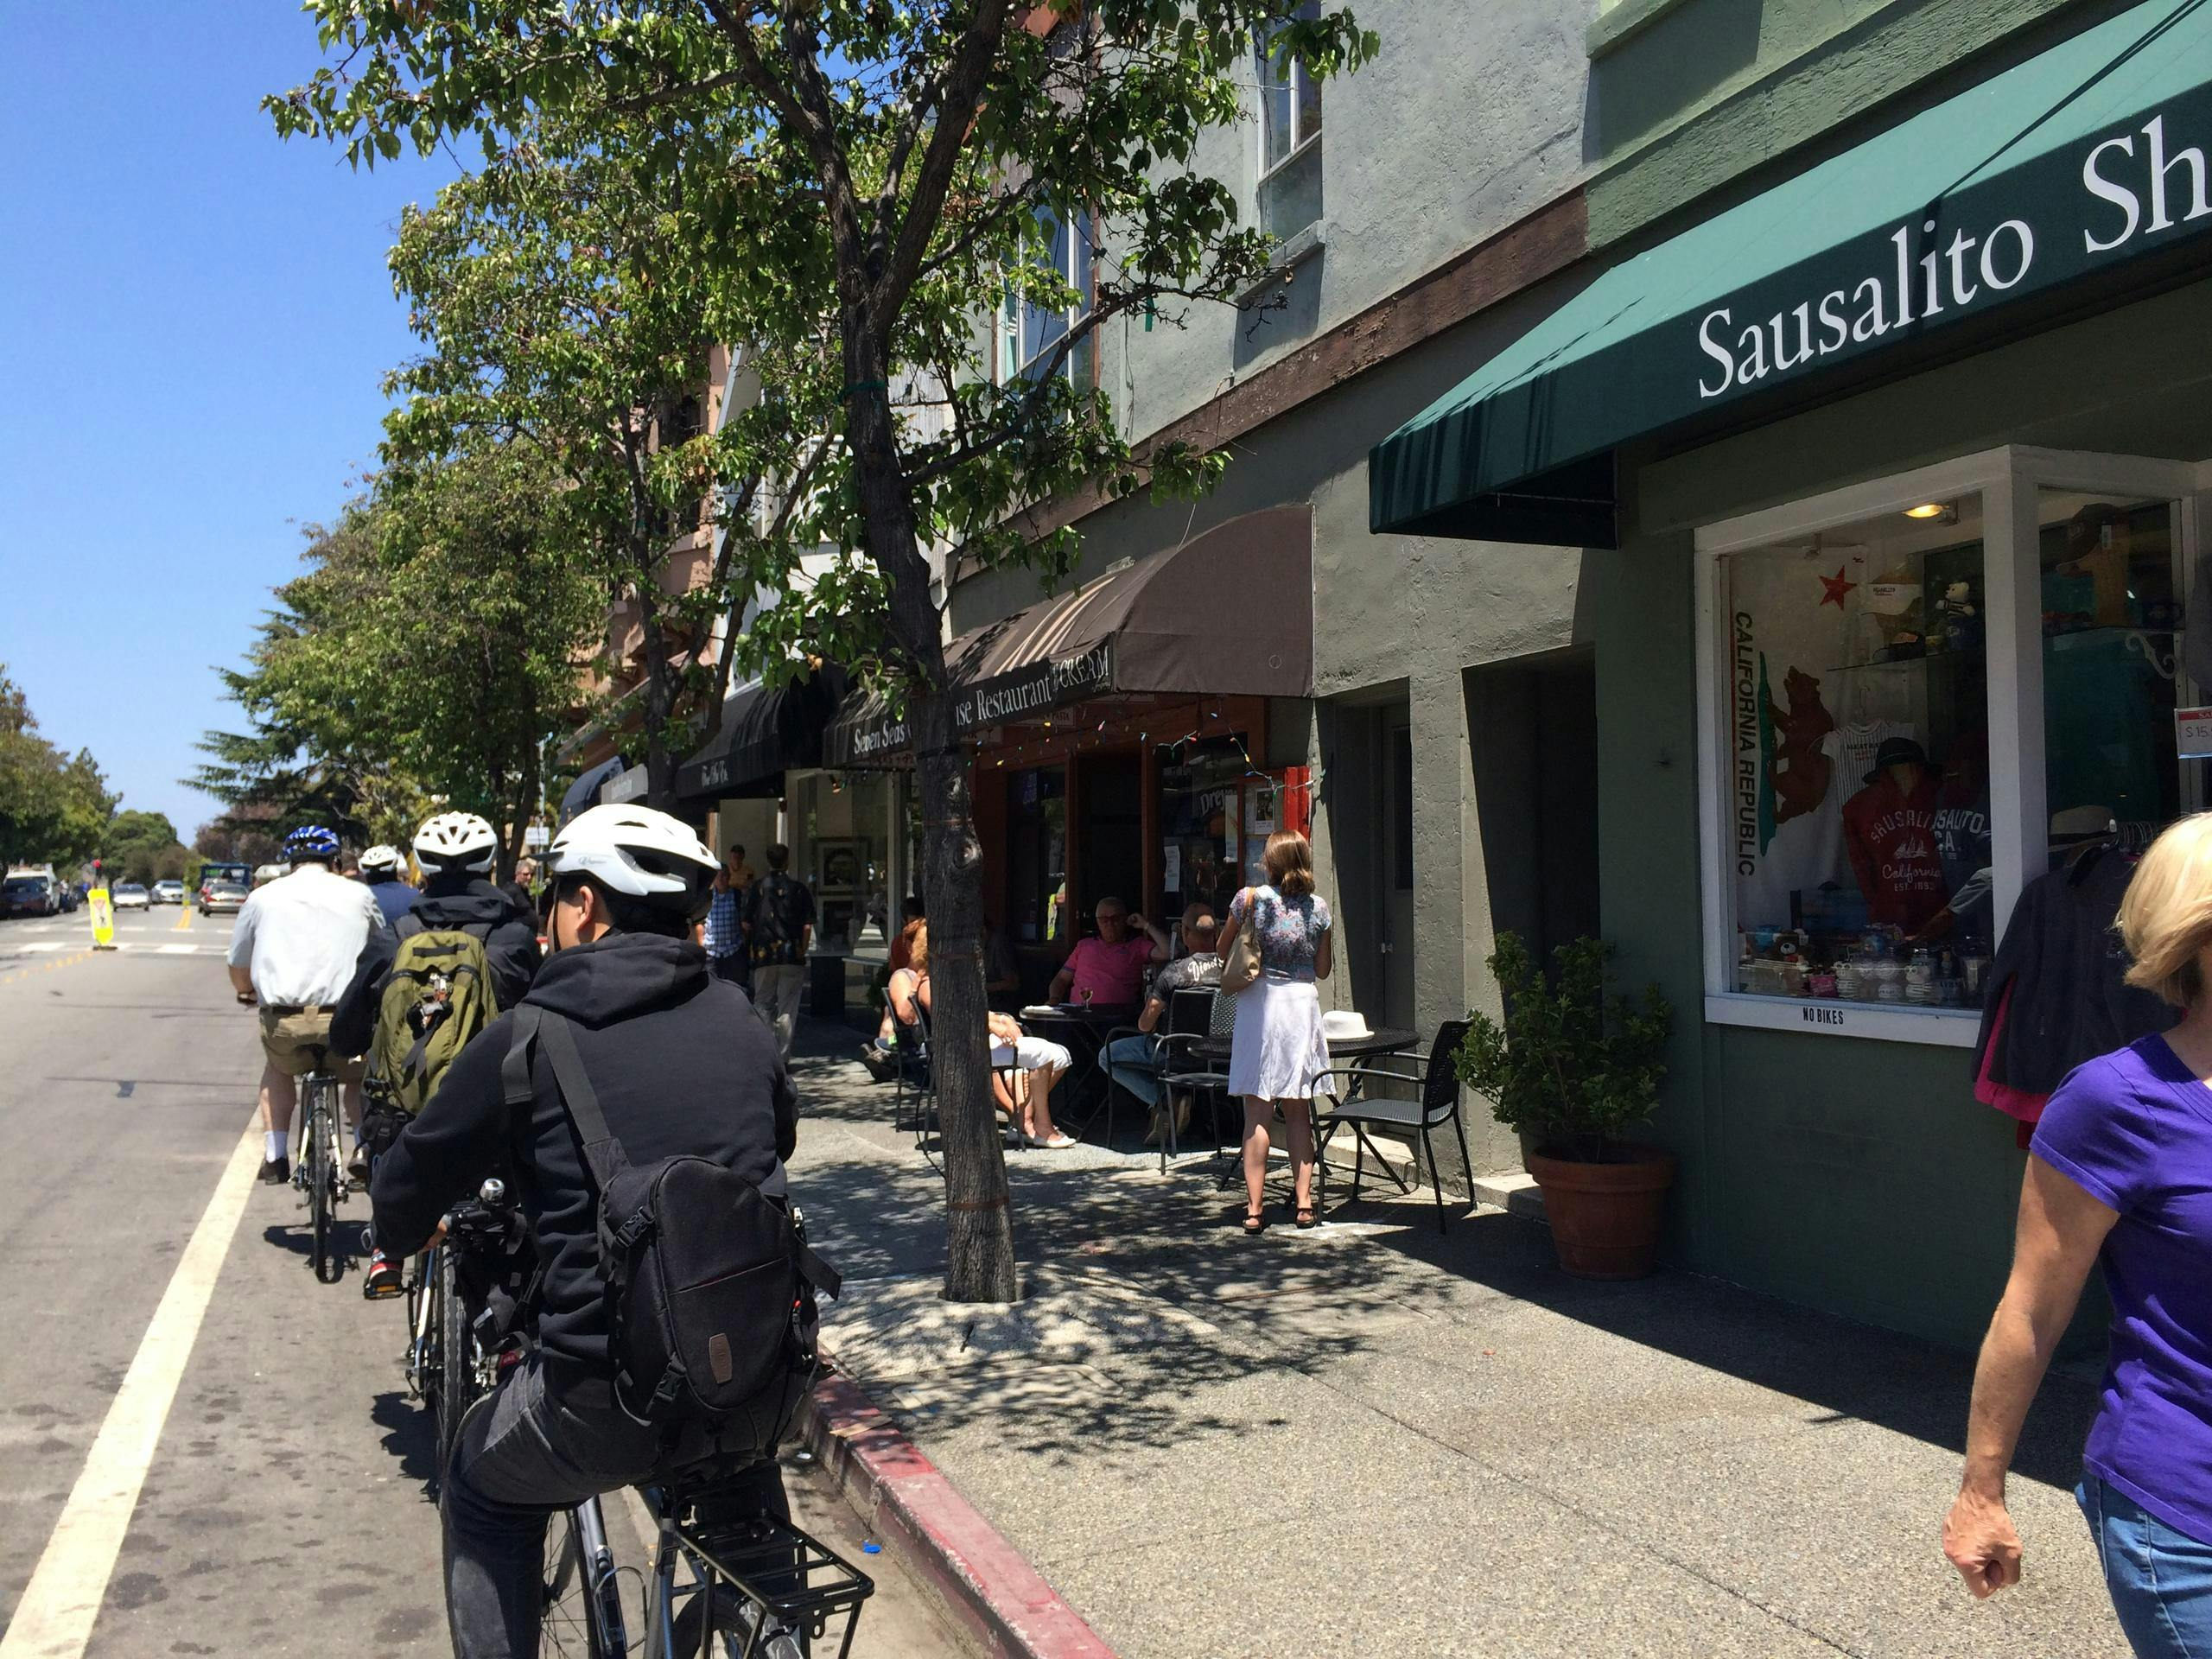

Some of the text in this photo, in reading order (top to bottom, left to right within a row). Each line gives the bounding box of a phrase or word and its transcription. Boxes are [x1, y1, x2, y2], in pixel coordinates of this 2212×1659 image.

[1699, 113, 2212, 399] Sausalito Sh
[1059, 645, 1109, 689] CREAM
[976, 674, 1052, 721] Restaurant
[2198, 710, 2212, 719] SA
[854, 727, 880, 754] Seven
[881, 718, 906, 749] Seas
[1735, 611, 1757, 876] CALIFORNIA REPUBLIC
[1882, 863, 1942, 883] California
[1802, 1007, 1844, 1025] NO BIKES
